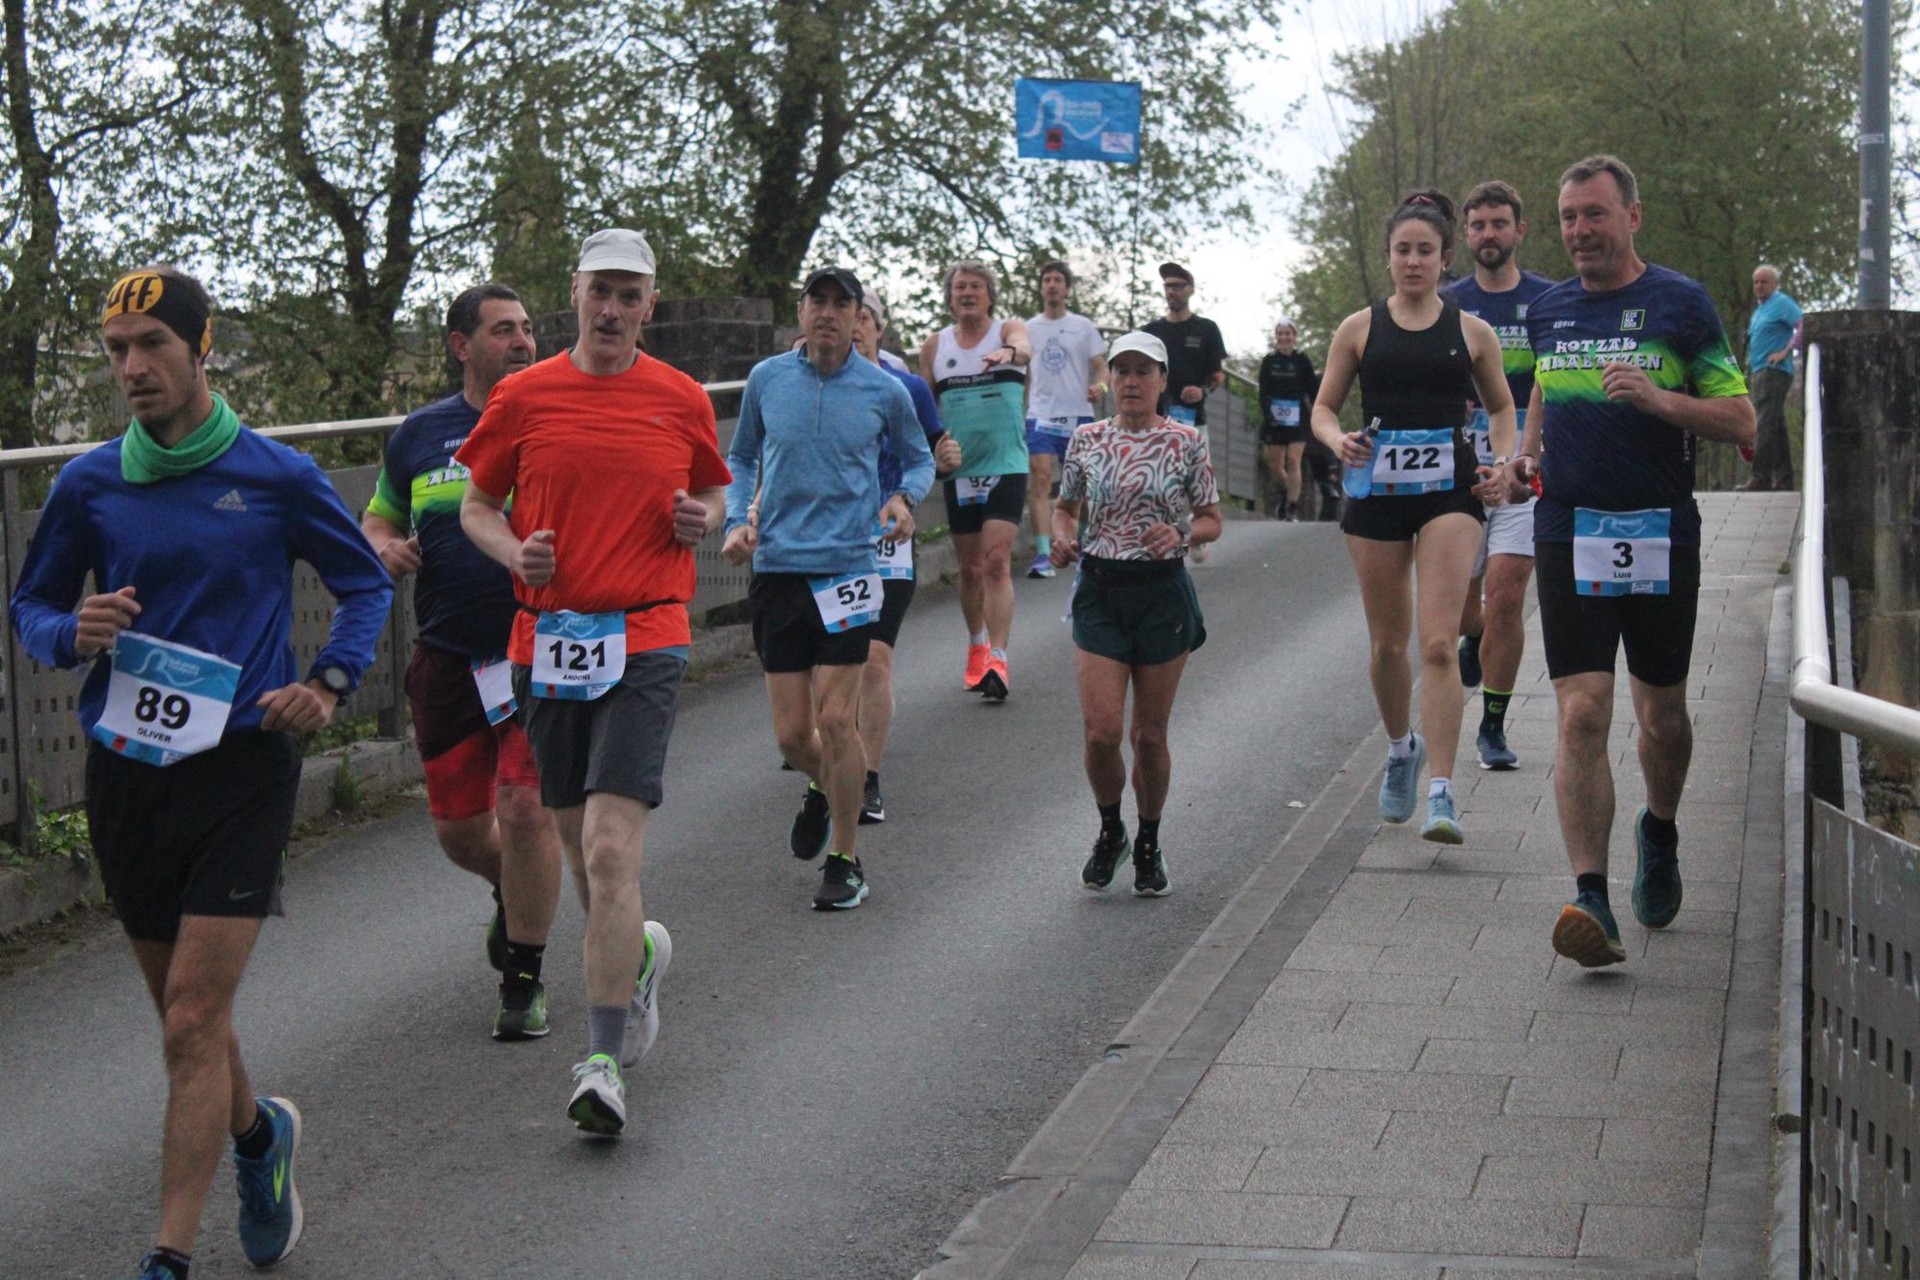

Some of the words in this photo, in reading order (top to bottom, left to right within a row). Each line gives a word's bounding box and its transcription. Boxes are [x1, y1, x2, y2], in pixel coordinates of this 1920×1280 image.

[107, 276, 160, 312] UFF
[1384, 447, 1440, 470] 122
[1612, 541, 1634, 569] 3
[836, 578, 871, 605] 52
[548, 639, 606, 670] 121
[134, 686, 191, 730] 89
[136, 727, 172, 743] OLIVER
